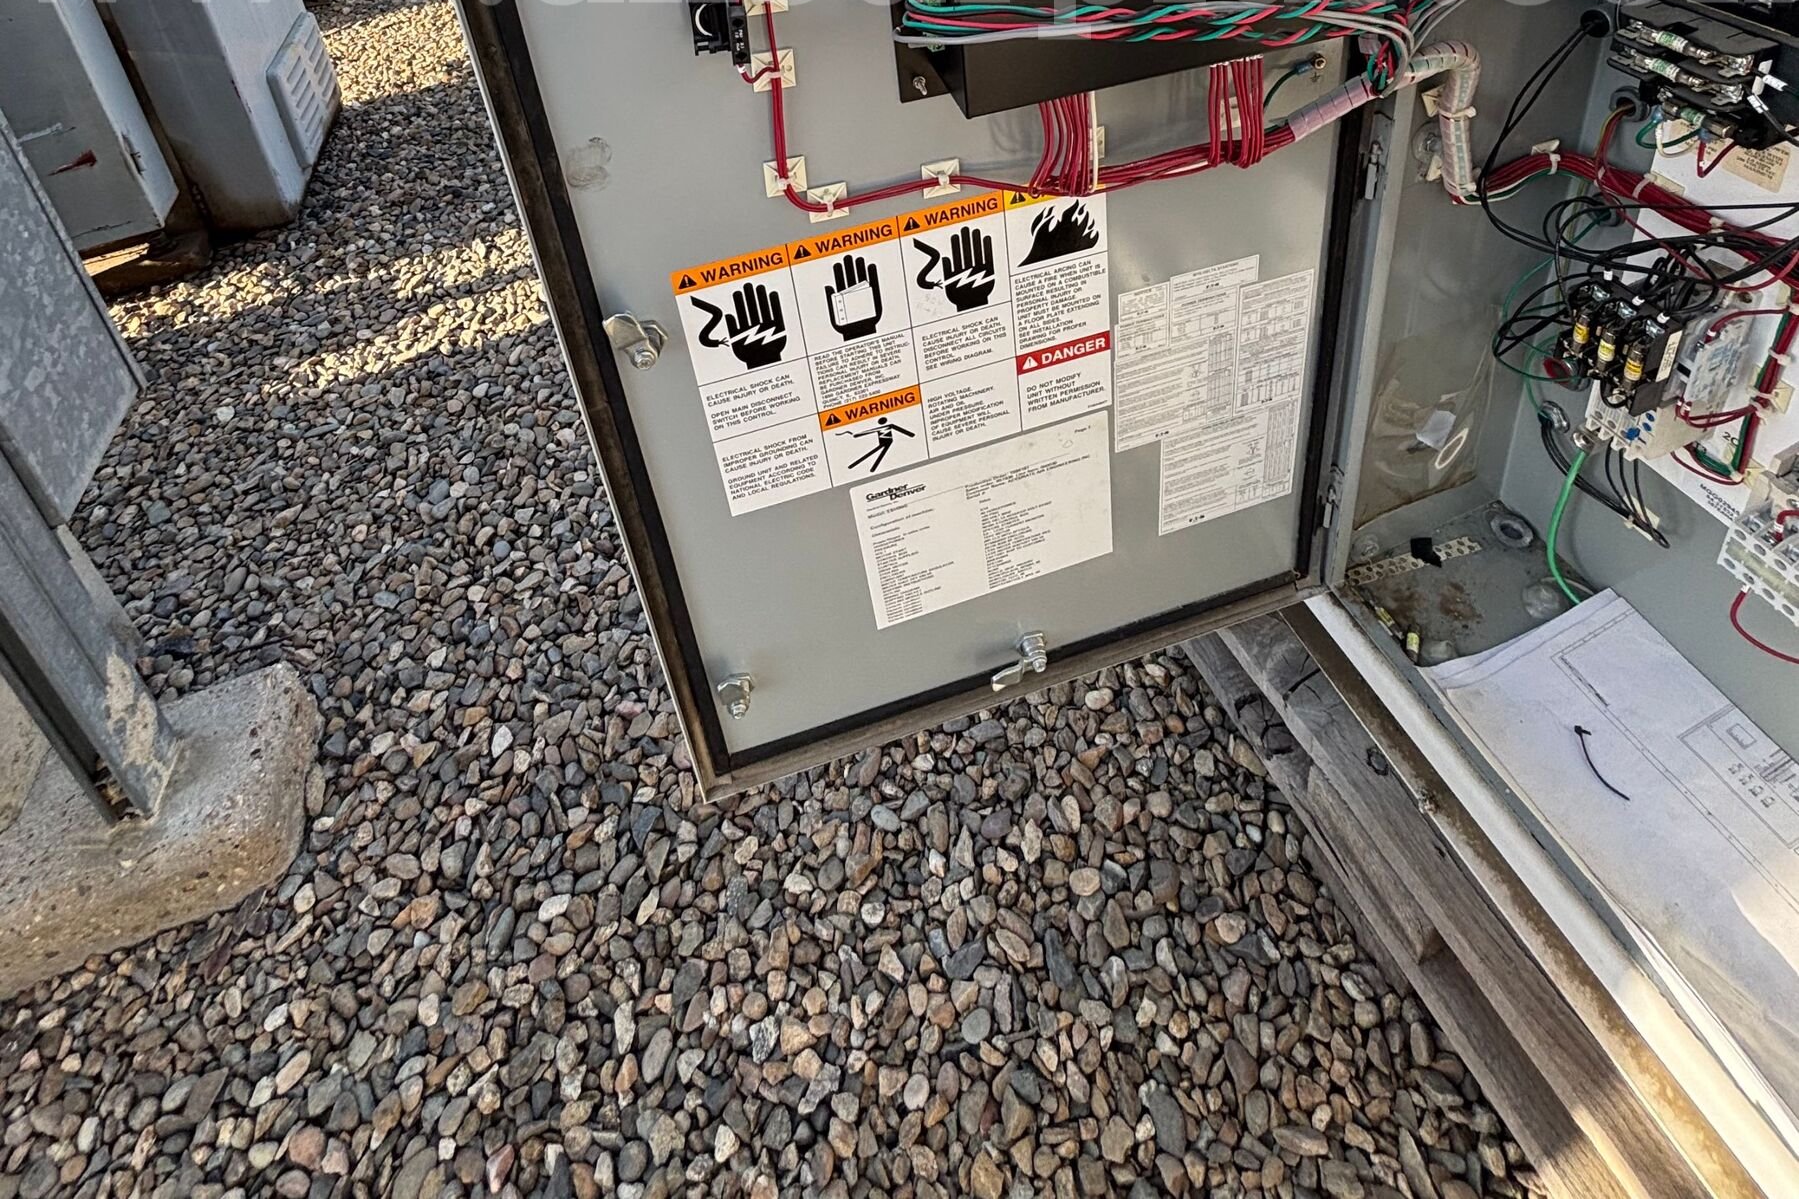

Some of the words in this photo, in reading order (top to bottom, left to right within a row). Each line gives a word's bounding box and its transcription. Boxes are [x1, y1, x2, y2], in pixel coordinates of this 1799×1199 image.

[924, 198, 998, 226] WARNING
[815, 224, 893, 253] WARNING
[700, 252, 784, 283] WARNING
[1042, 337, 1105, 365] DANGER
[707, 386, 747, 401] ELECTRICAL
[750, 379, 773, 389] SHOCK
[776, 374, 790, 382] CAN
[1028, 393, 1057, 405] WRITTEN
[1060, 380, 1100, 396] PERMISSION
[1040, 380, 1052, 388] NOT
[1056, 372, 1081, 383] MODIFY
[1045, 381, 1075, 393] WITHOUT
[708, 397, 730, 407] CAUSE
[733, 390, 756, 400] INJURY
[711, 410, 729, 418] OPEN
[732, 404, 748, 412] MAIN
[751, 392, 792, 407] DISCONNECT
[713, 414, 738, 424] SWITCH
[741, 406, 766, 416] BEFORE
[770, 396, 800, 408] WORKING
[844, 392, 915, 420] WARNING
[1029, 403, 1047, 412] FROM
[727, 419, 741, 427] THIS
[866, 484, 908, 501] Gardner
[890, 485, 926, 500] Denver
